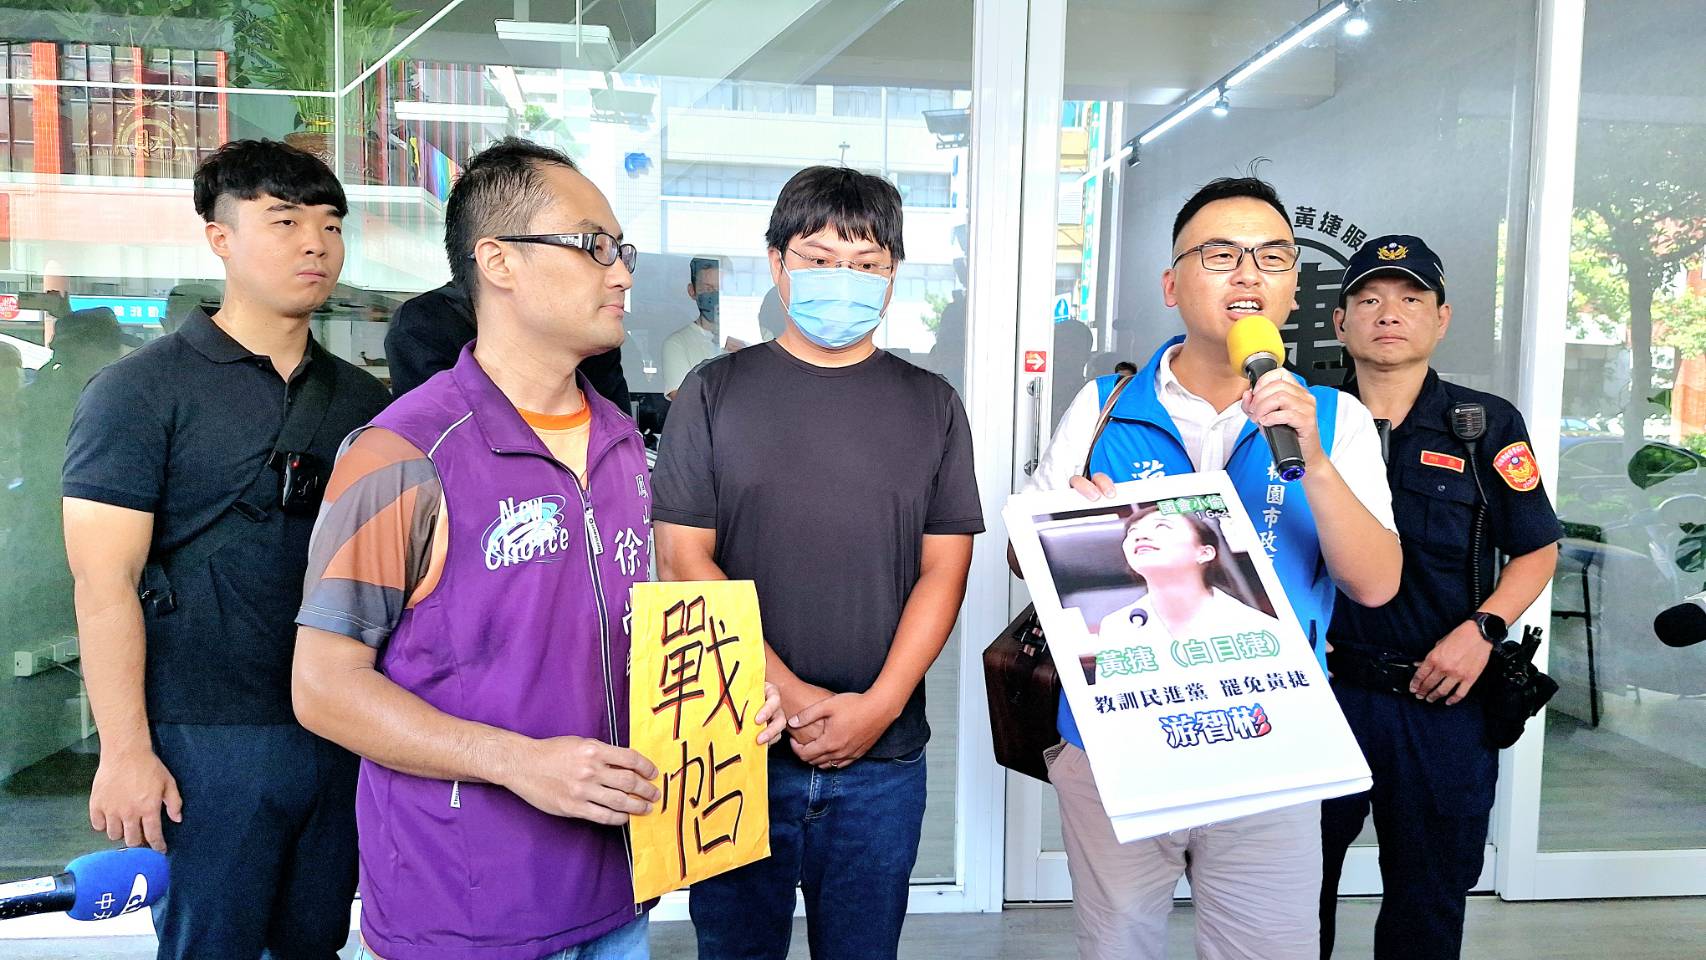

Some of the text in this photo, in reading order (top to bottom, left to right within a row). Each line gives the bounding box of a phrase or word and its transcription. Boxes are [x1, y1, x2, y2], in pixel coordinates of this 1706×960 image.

[498, 497, 544, 526] New
[1259, 461, 1288, 558] 桃園市政
[485, 526, 570, 571] Choice
[1094, 682, 1209, 714] 教訓民進黨
[651, 594, 749, 881] 戰帖
[1158, 703, 1272, 748] 游智彬
